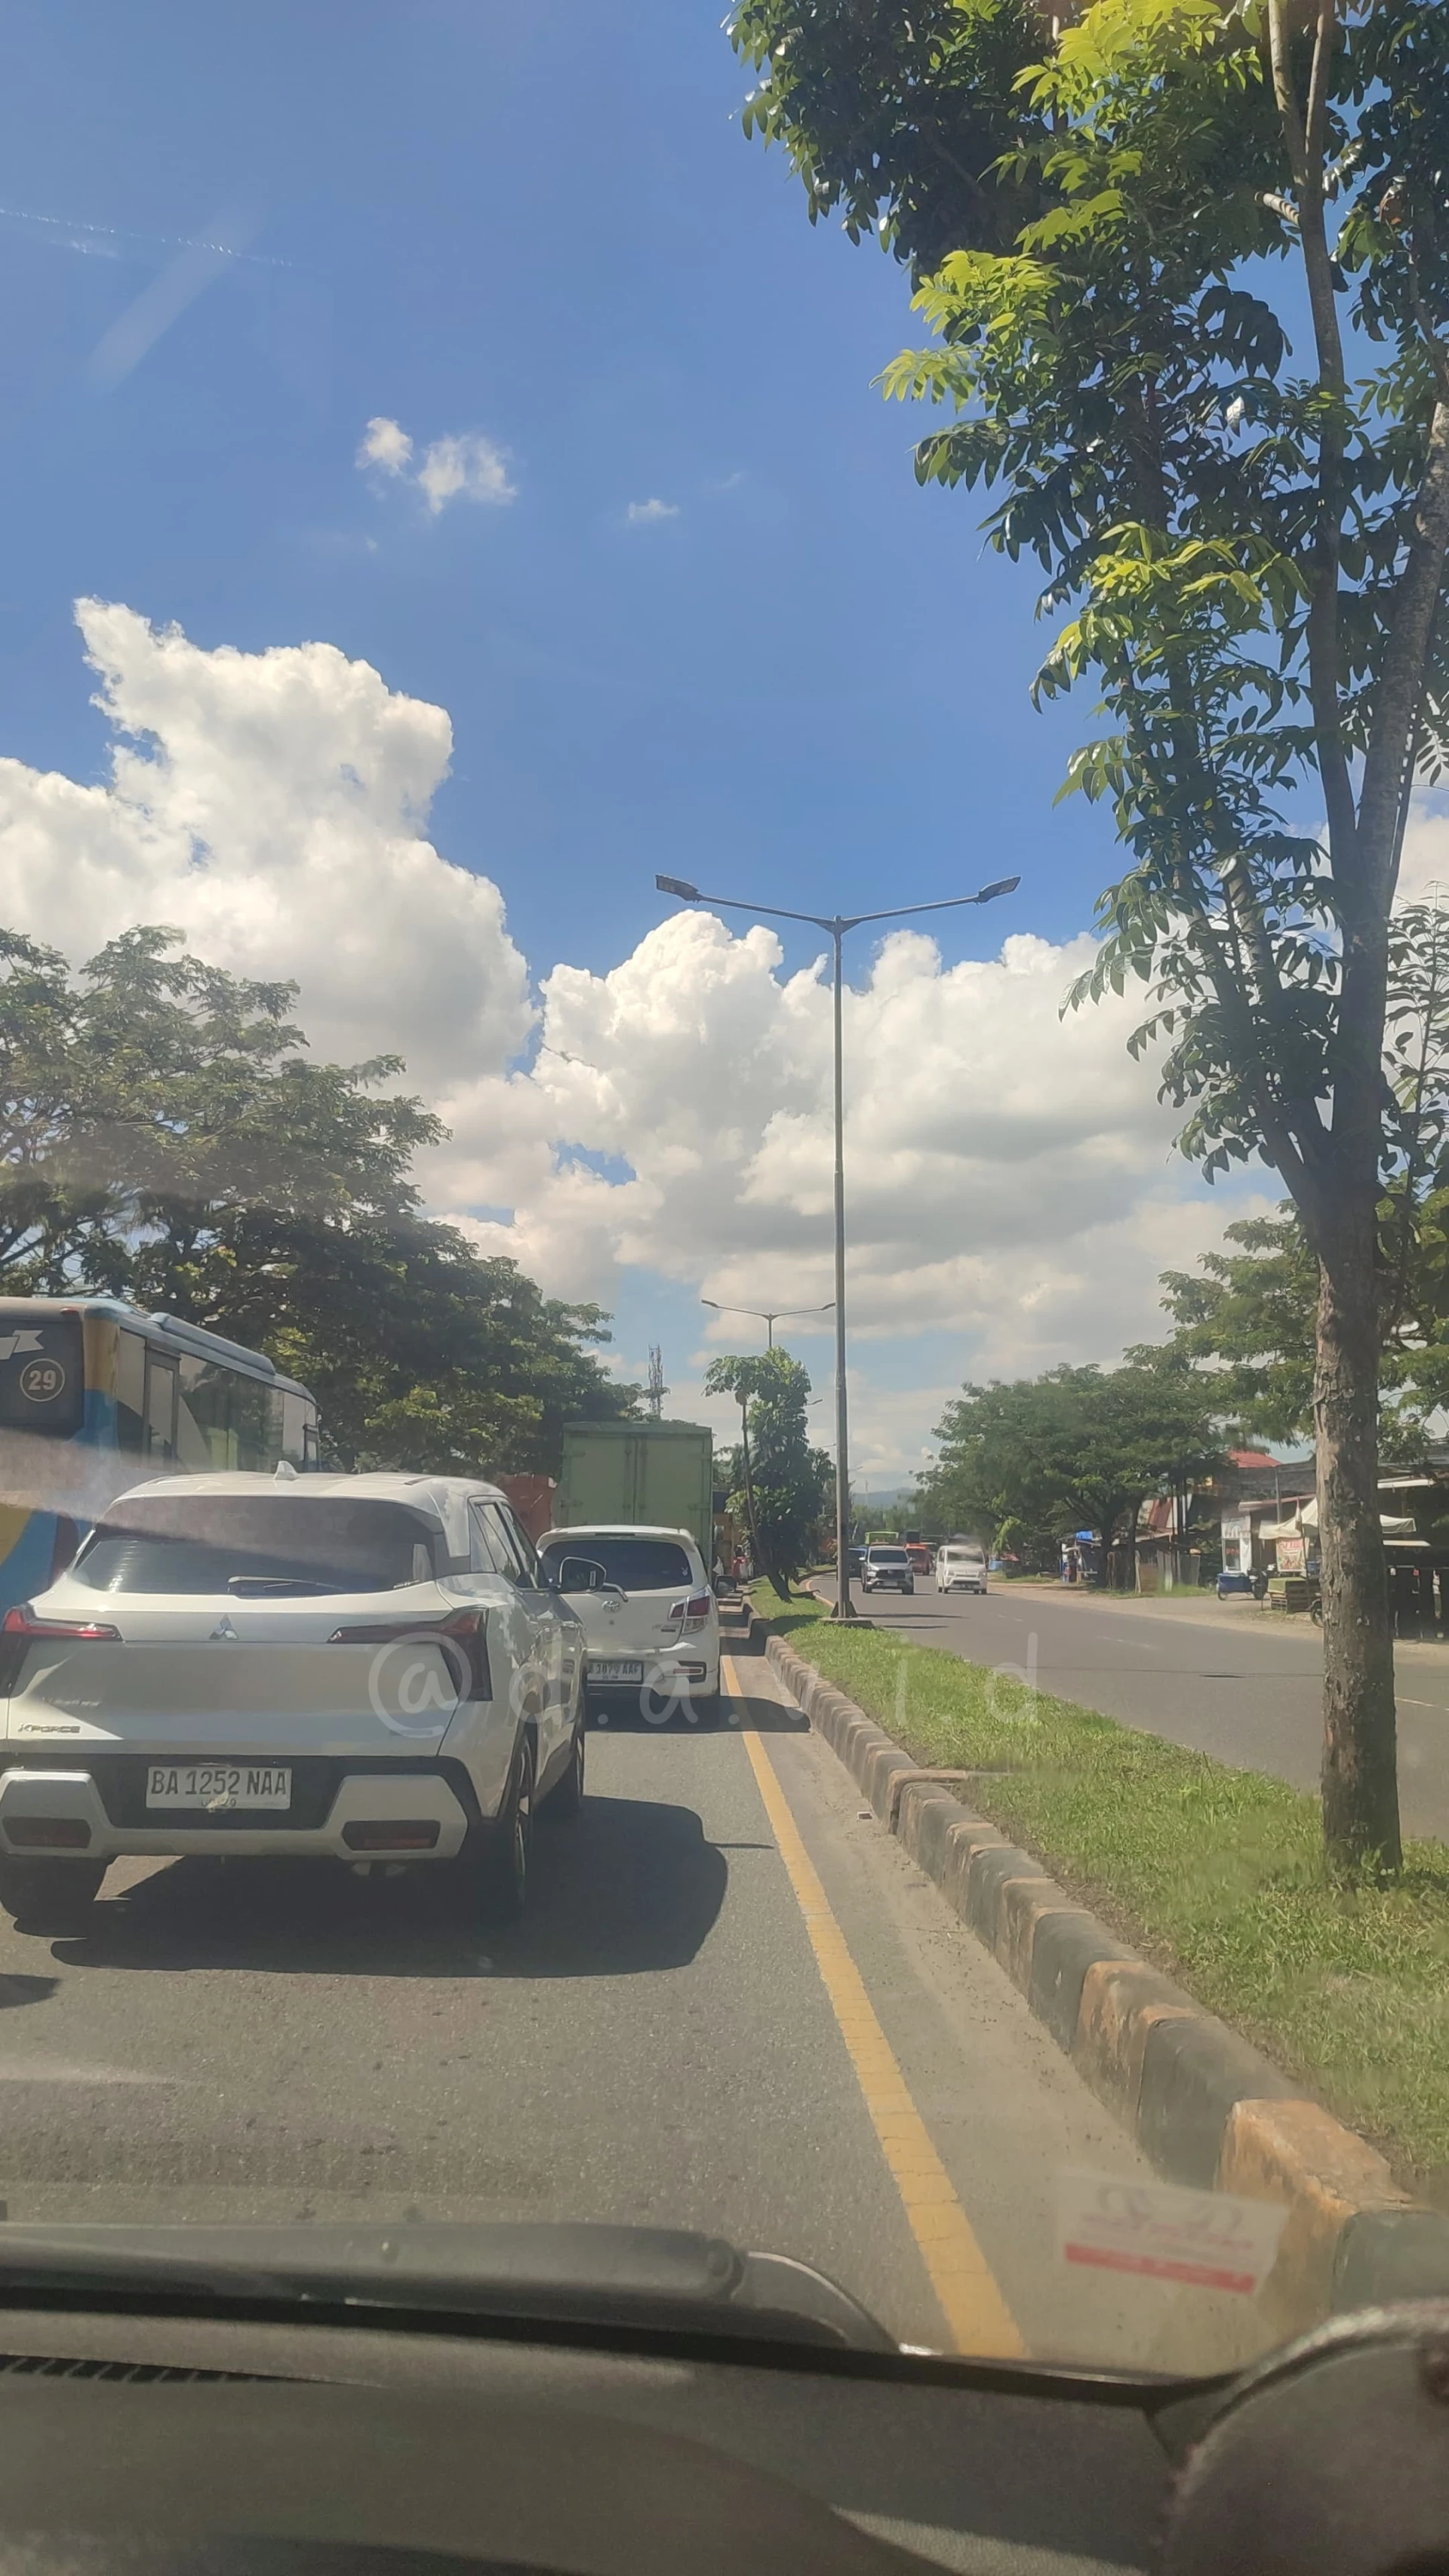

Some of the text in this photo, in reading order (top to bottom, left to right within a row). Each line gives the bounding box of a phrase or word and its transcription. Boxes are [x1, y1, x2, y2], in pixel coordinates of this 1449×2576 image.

[29, 1370, 56, 1390] 29
[151, 1770, 287, 1796] BA 1252 NAA
